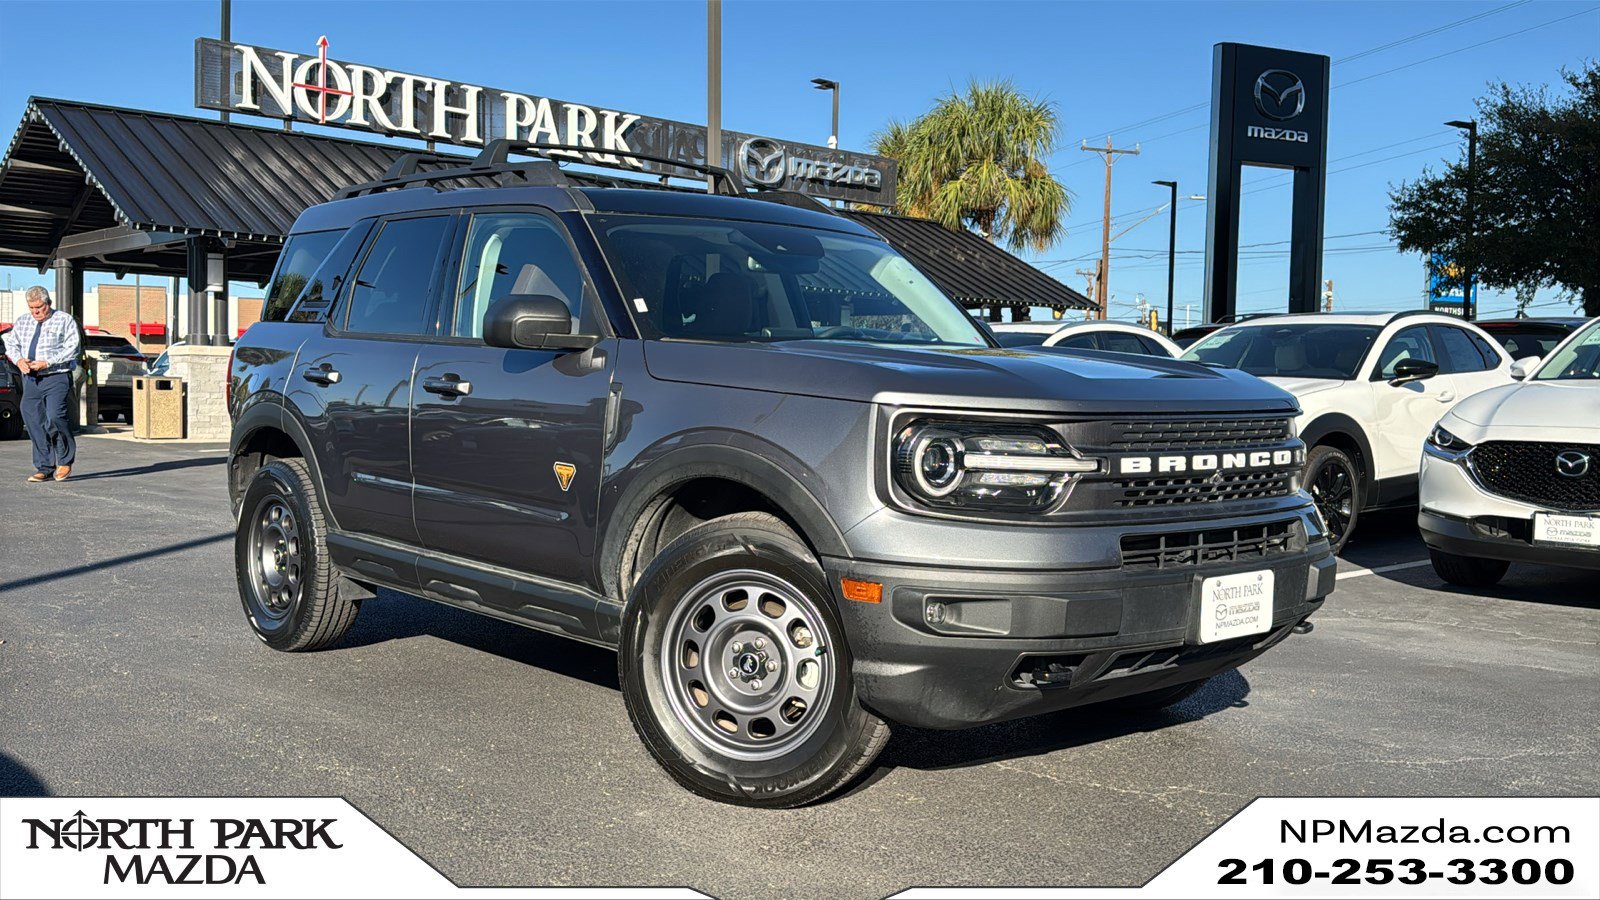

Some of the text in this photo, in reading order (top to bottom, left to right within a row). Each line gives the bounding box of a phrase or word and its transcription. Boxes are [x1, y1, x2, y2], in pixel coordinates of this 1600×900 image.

[234, 43, 644, 167] NORTH PARK
[1247, 125, 1308, 143] mazda
[788, 156, 882, 188] mazda
[1120, 450, 1292, 474] BRONCO
[1212, 582, 1264, 602] NORTH PARK
